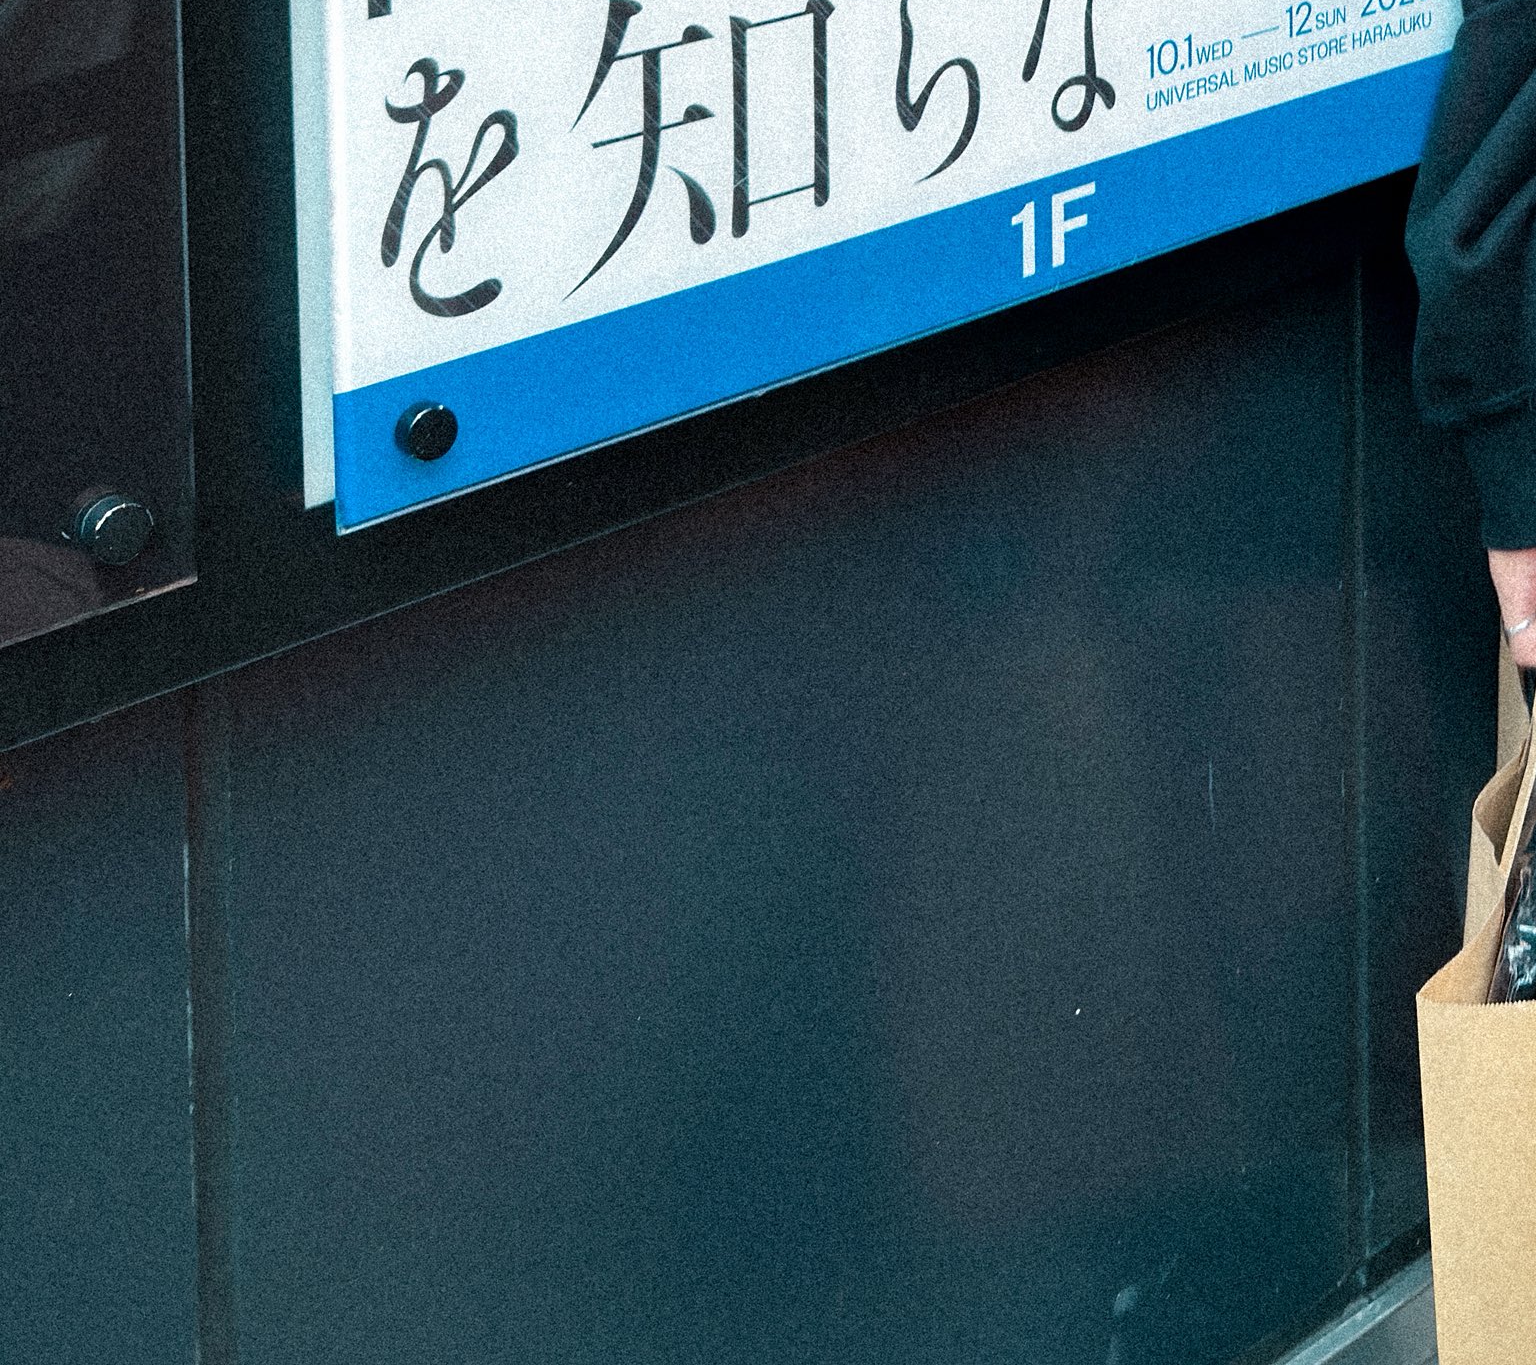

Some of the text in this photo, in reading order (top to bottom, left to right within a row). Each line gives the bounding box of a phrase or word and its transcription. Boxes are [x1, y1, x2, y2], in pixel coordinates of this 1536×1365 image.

[1146, 11, 1433, 113] UNIVERSAL MUSIC STORE HARAJUKU
[1010, 181, 1097, 279] 1F
